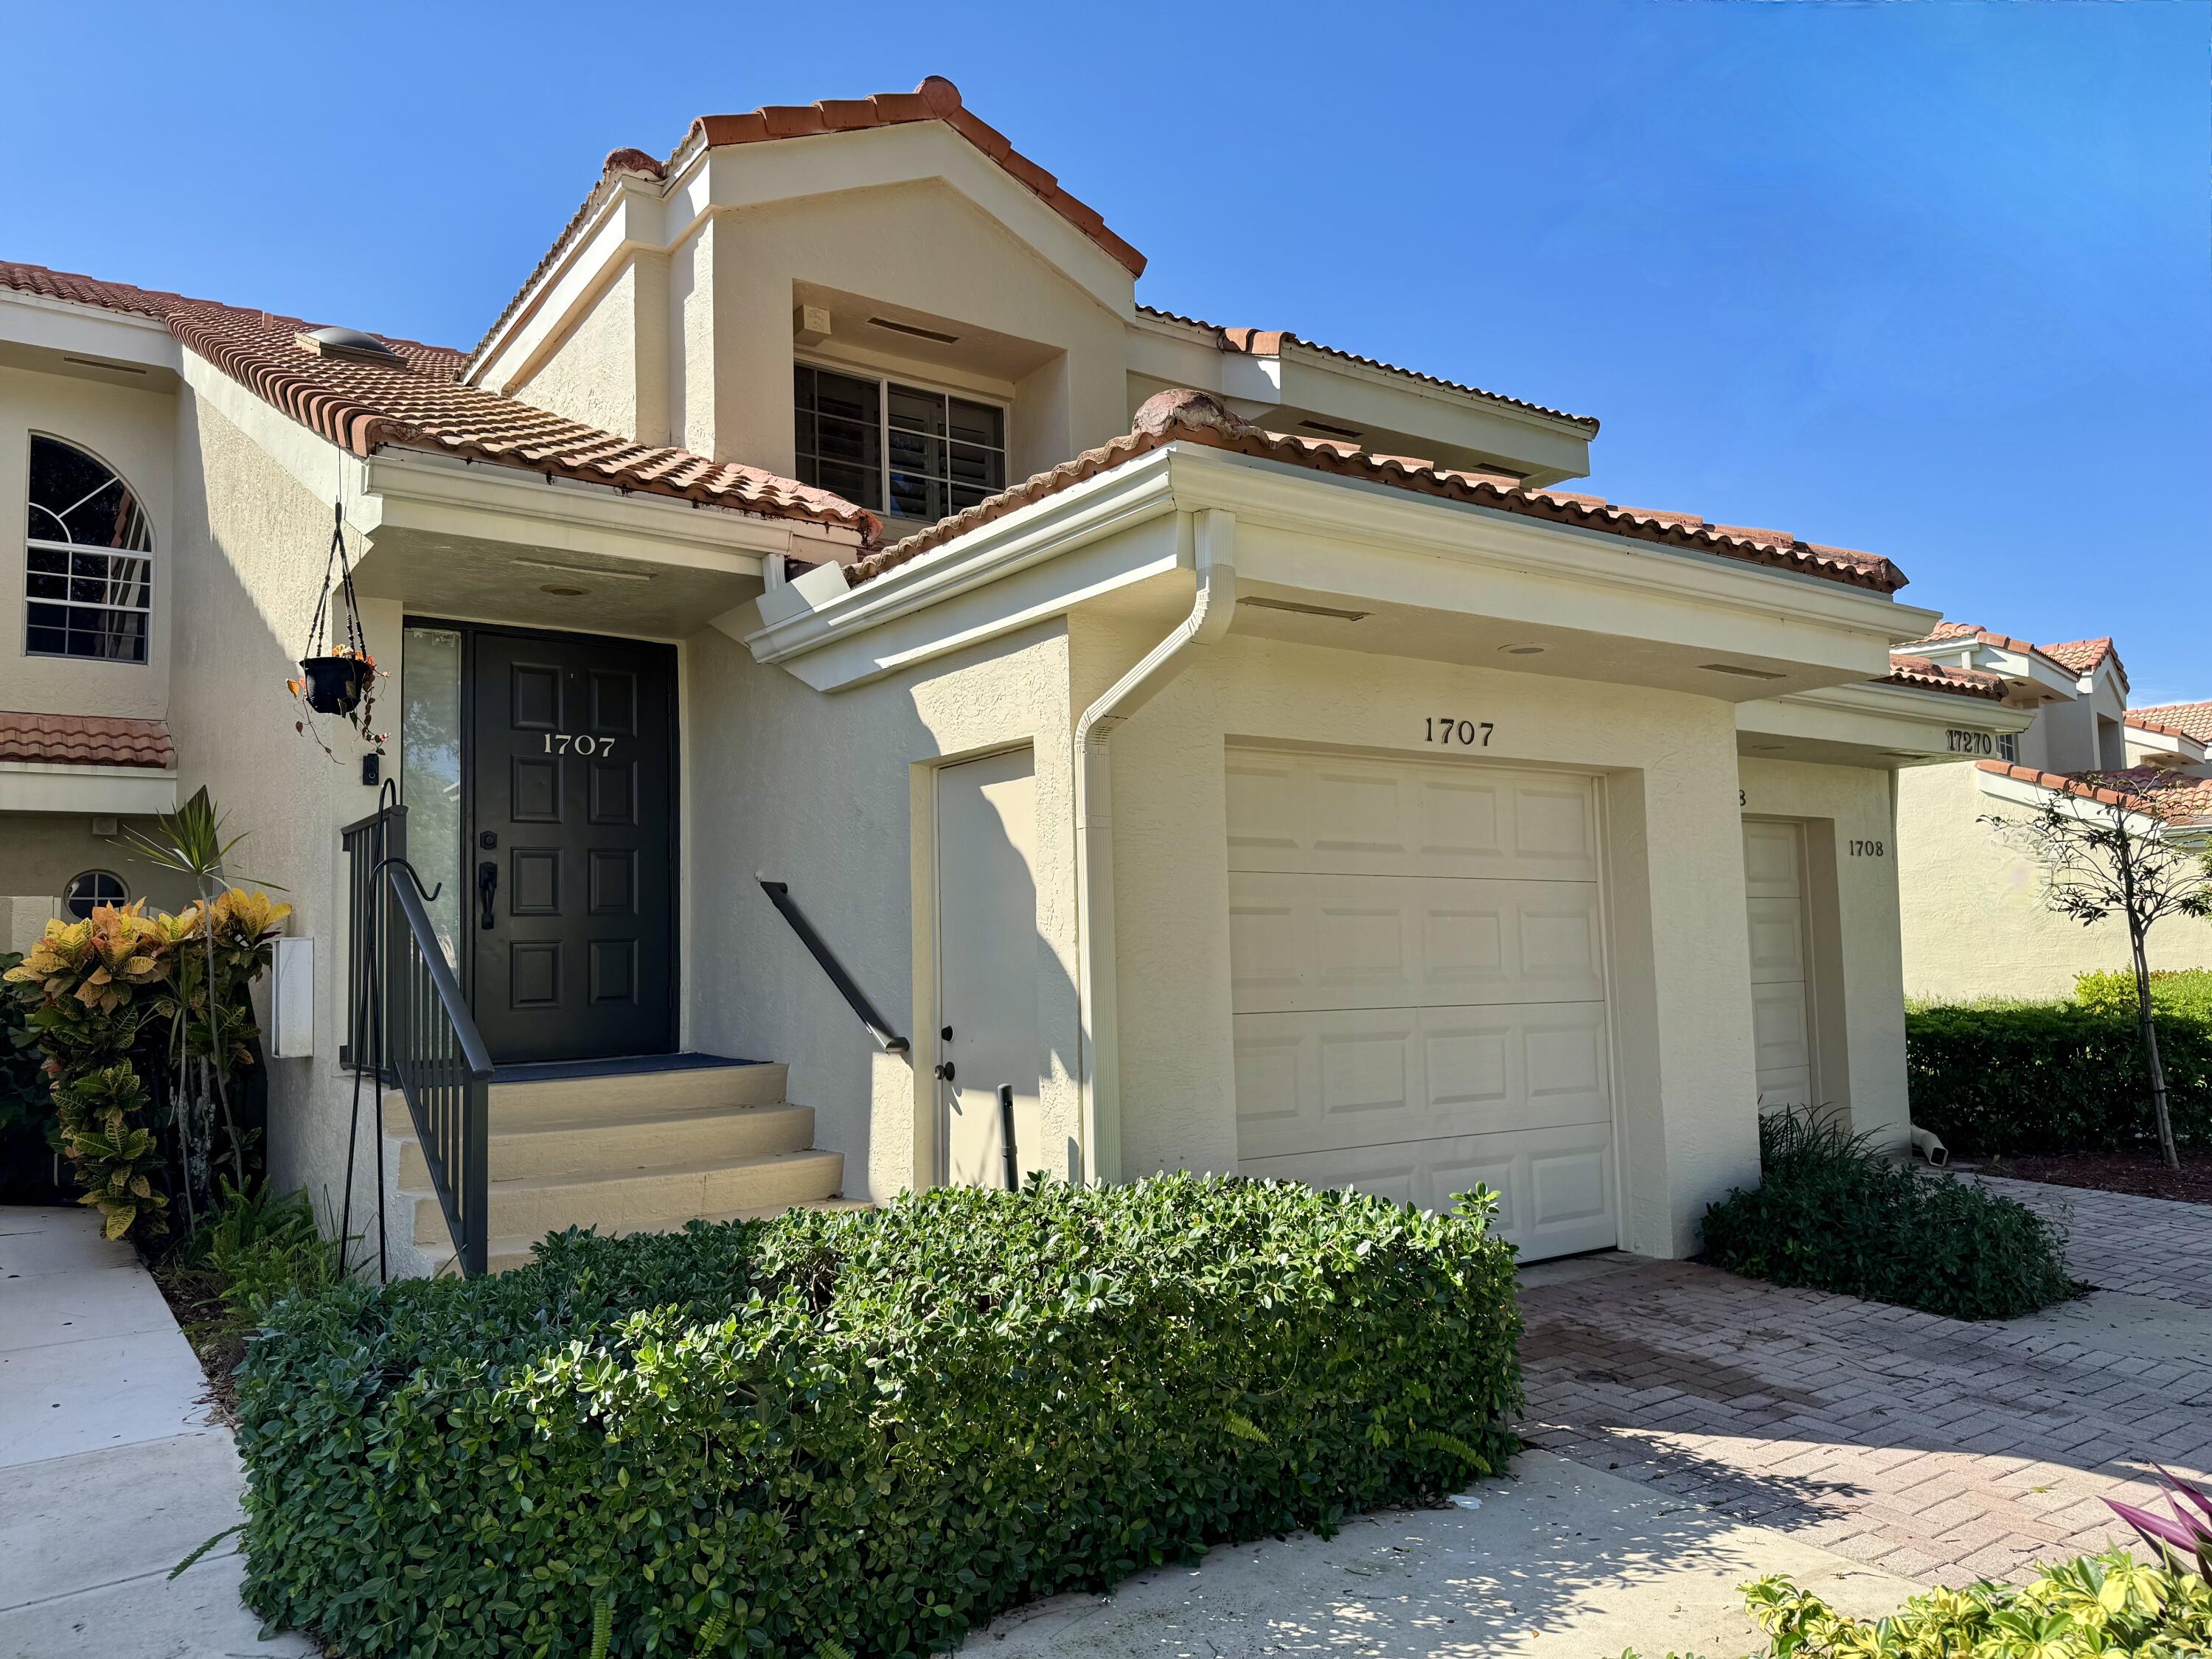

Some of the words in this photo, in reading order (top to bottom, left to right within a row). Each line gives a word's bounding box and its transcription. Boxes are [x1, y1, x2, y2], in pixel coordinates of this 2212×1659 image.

[1425, 717, 1494, 747] 1707
[1946, 729, 1992, 755] 17270
[544, 733, 615, 757] 1707
[1849, 840, 1884, 857] 1708
